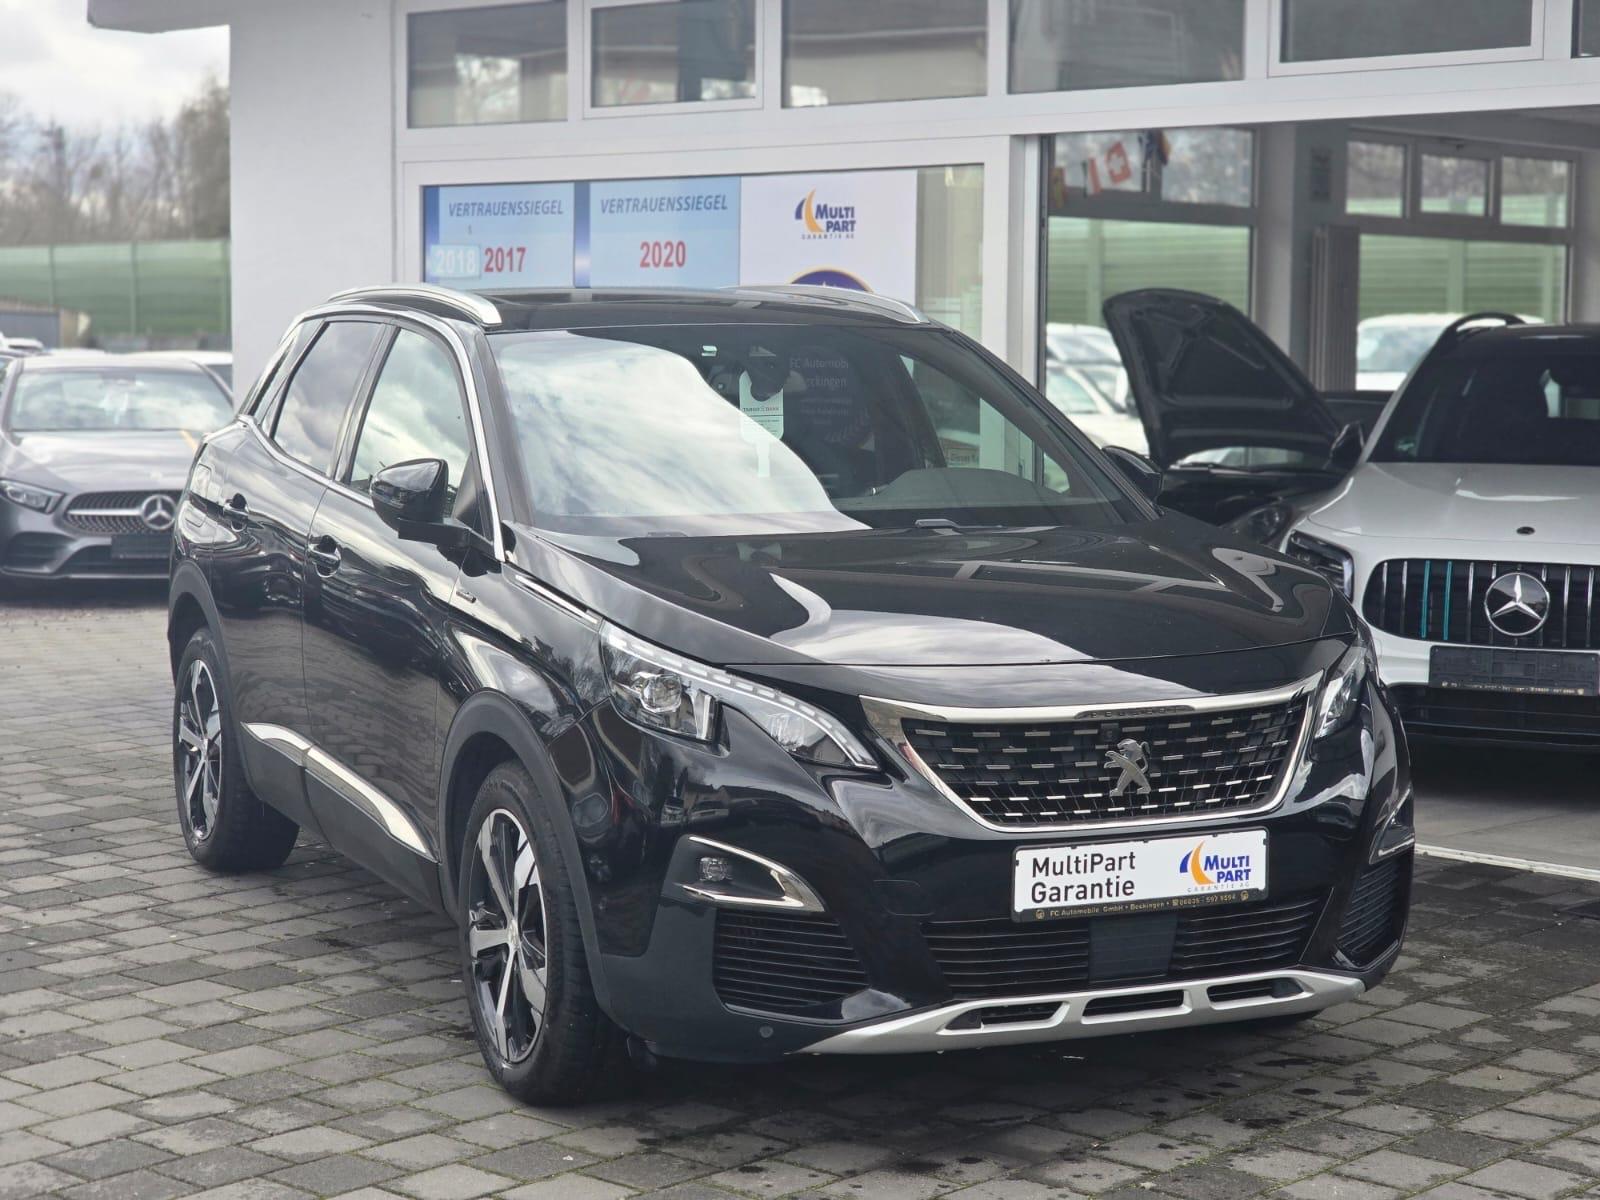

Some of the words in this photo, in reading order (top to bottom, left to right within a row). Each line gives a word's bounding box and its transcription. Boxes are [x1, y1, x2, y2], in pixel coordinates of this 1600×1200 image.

[448, 199, 563, 217] VERTRAUENSSIEGEL
[601, 194, 728, 214] VERTRAUENSSIEGEL
[815, 203, 855, 219] MULTI
[826, 220, 856, 233] PART
[434, 249, 476, 274] 2018
[484, 246, 526, 273] 2017
[640, 240, 686, 268] 2020
[1032, 851, 1136, 878] MultiPart
[1203, 855, 1250, 871] MULTI
[1217, 869, 1251, 883] PART
[1031, 875, 1135, 904] Garantie
[1061, 907, 1100, 916] Automobile
